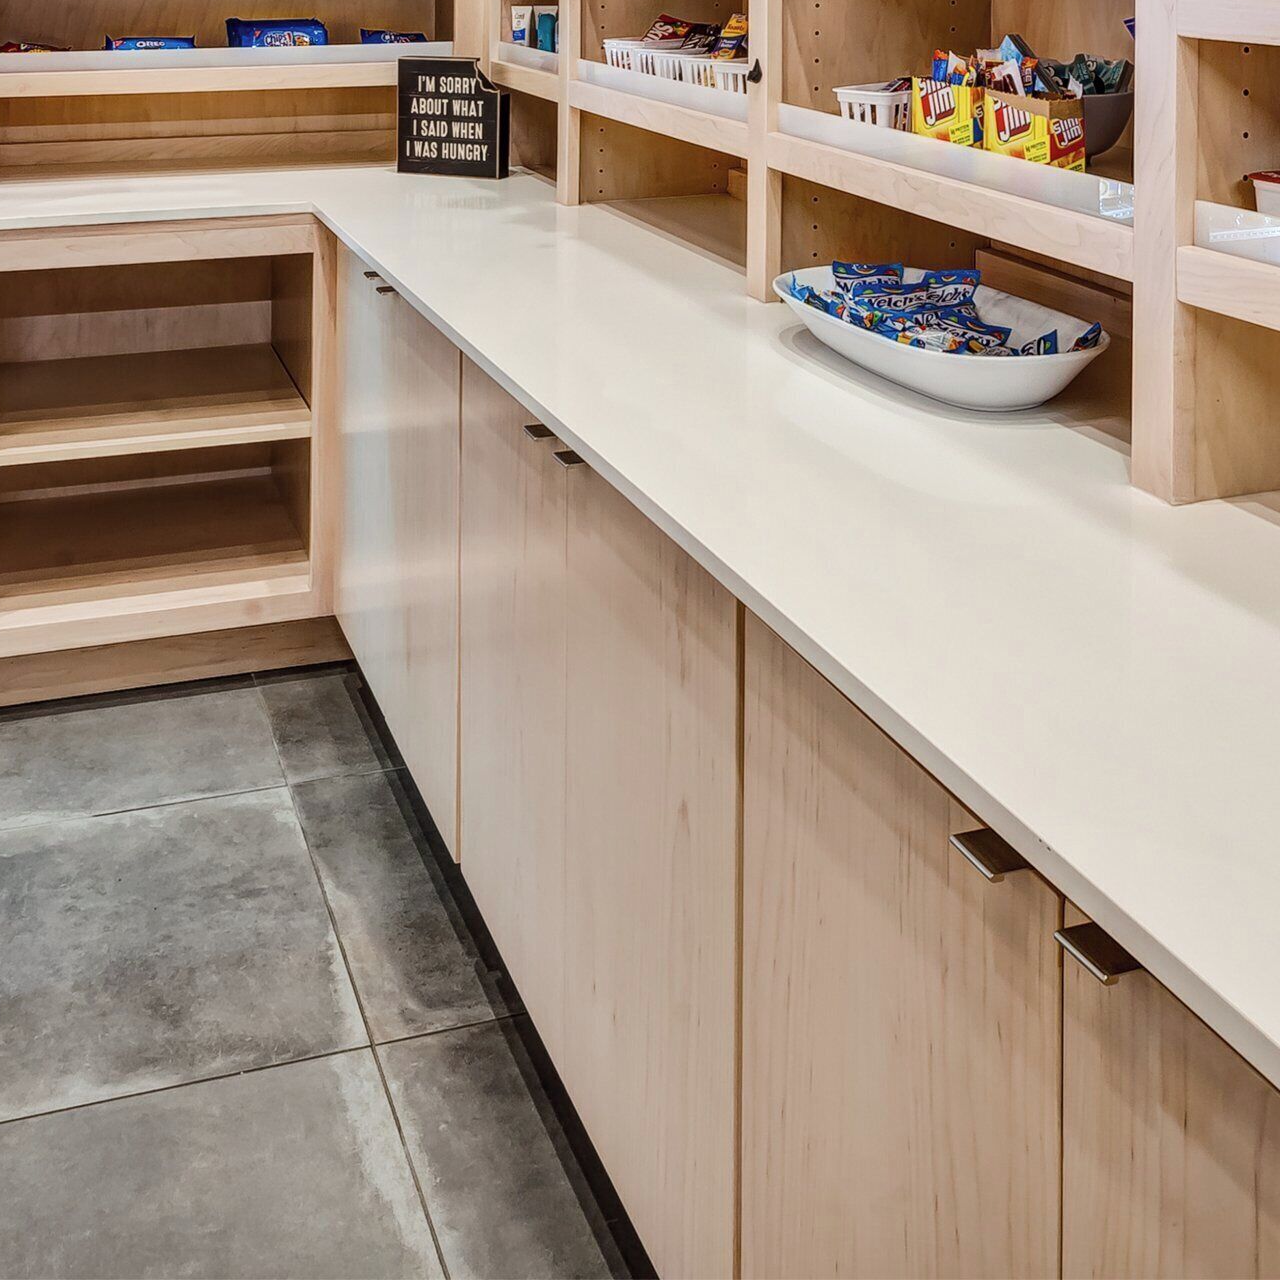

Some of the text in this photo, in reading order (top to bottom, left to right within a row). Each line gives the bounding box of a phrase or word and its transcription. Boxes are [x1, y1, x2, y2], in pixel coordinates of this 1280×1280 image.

[136, 40, 166, 48] OREO
[418, 75, 477, 94] I'M SORRY
[410, 97, 484, 117] ABOUT WHAT
[413, 119, 483, 139] I SAID WHEN
[406, 140, 488, 161] I WAS HUNGRY
[925, 286, 972, 305] elch's
